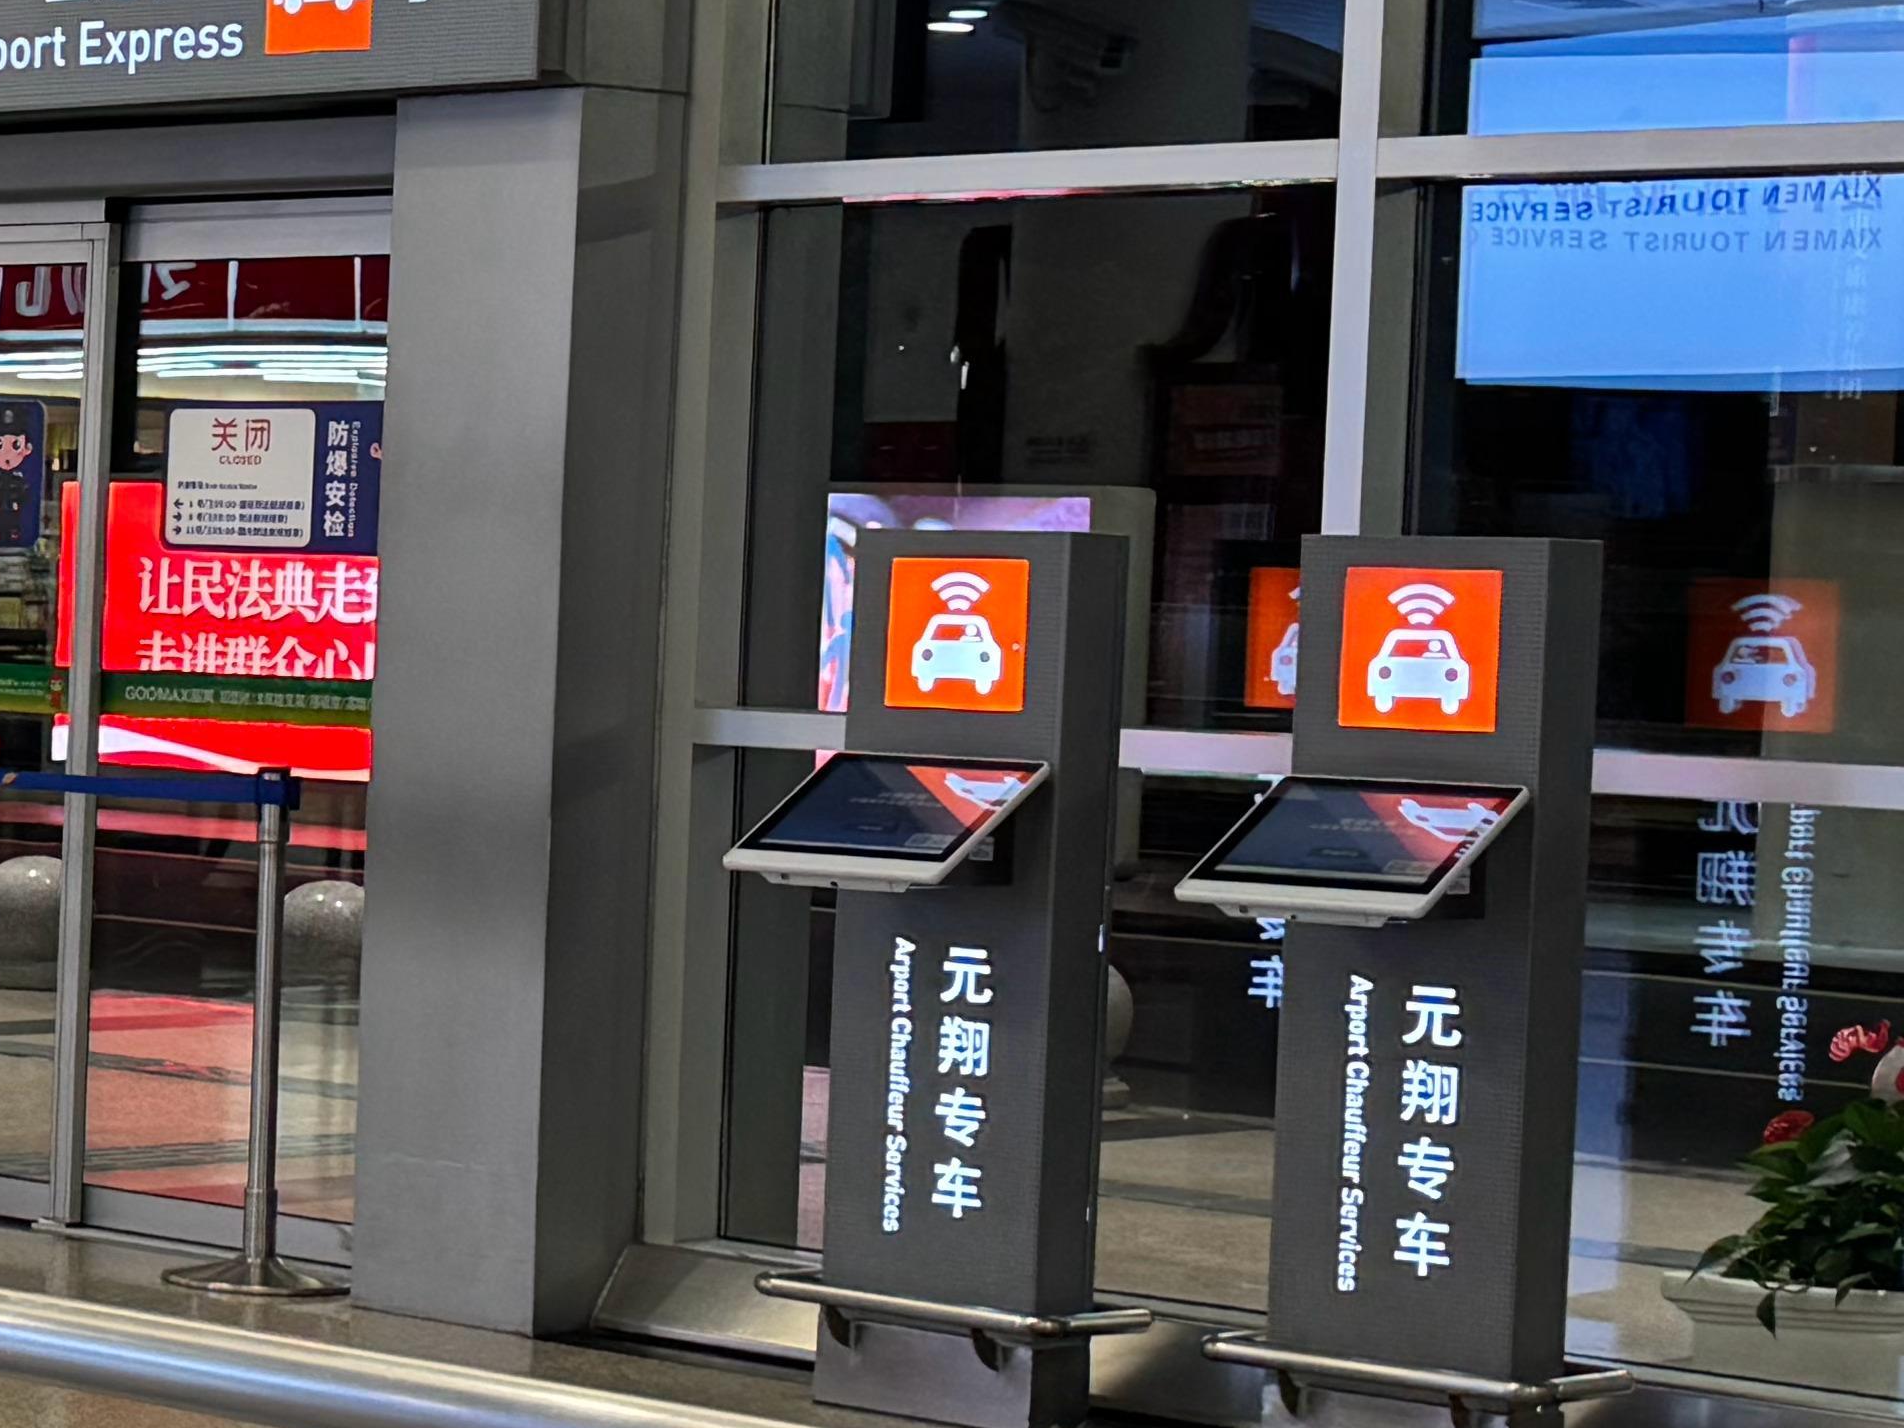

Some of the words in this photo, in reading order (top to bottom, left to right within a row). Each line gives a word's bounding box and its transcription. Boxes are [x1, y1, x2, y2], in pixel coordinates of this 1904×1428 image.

[79, 17, 243, 75] Express
[211, 417, 271, 452] 关闭
[888, 1017, 913, 1126] Chauffeur
[931, 946, 993, 1219] 元翔专车
[1341, 1060, 1370, 1182] Chauffeur
[882, 1134, 908, 1232] Services
[1393, 984, 1463, 1277] 元翔专车
[1337, 1186, 1365, 1292] Services
